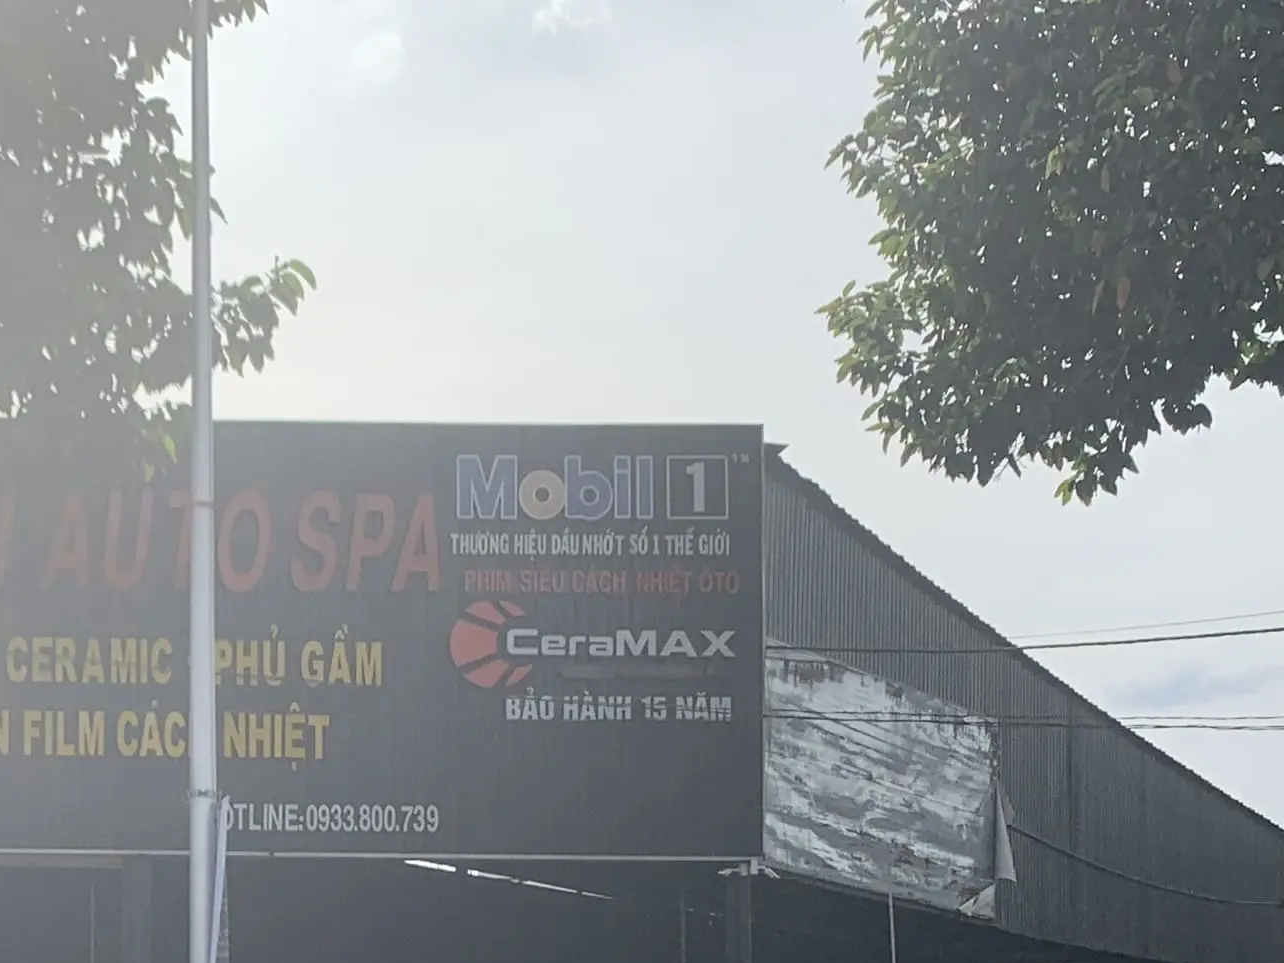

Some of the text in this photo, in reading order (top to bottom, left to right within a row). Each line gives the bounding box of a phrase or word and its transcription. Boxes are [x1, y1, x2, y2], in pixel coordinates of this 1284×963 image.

[455, 454, 654, 521] Mobil
[290, 490, 441, 593] SPA
[514, 528, 546, 560] HIỆU
[465, 569, 512, 593] PHIM
[5, 635, 173, 686] CERAMIC
[215, 623, 286, 687] PHỦ
[300, 623, 383, 688] GẦM
[506, 627, 737, 658] CeraMAX
[505, 686, 732, 721] BẢO HÀNH 15 NĂM
[22, 709, 106, 757] FILM
[116, 698, 188, 758] CÁC
[223, 701, 331, 771] NHIỆT
[222, 803, 440, 833] OTLINE:0933.800.739
